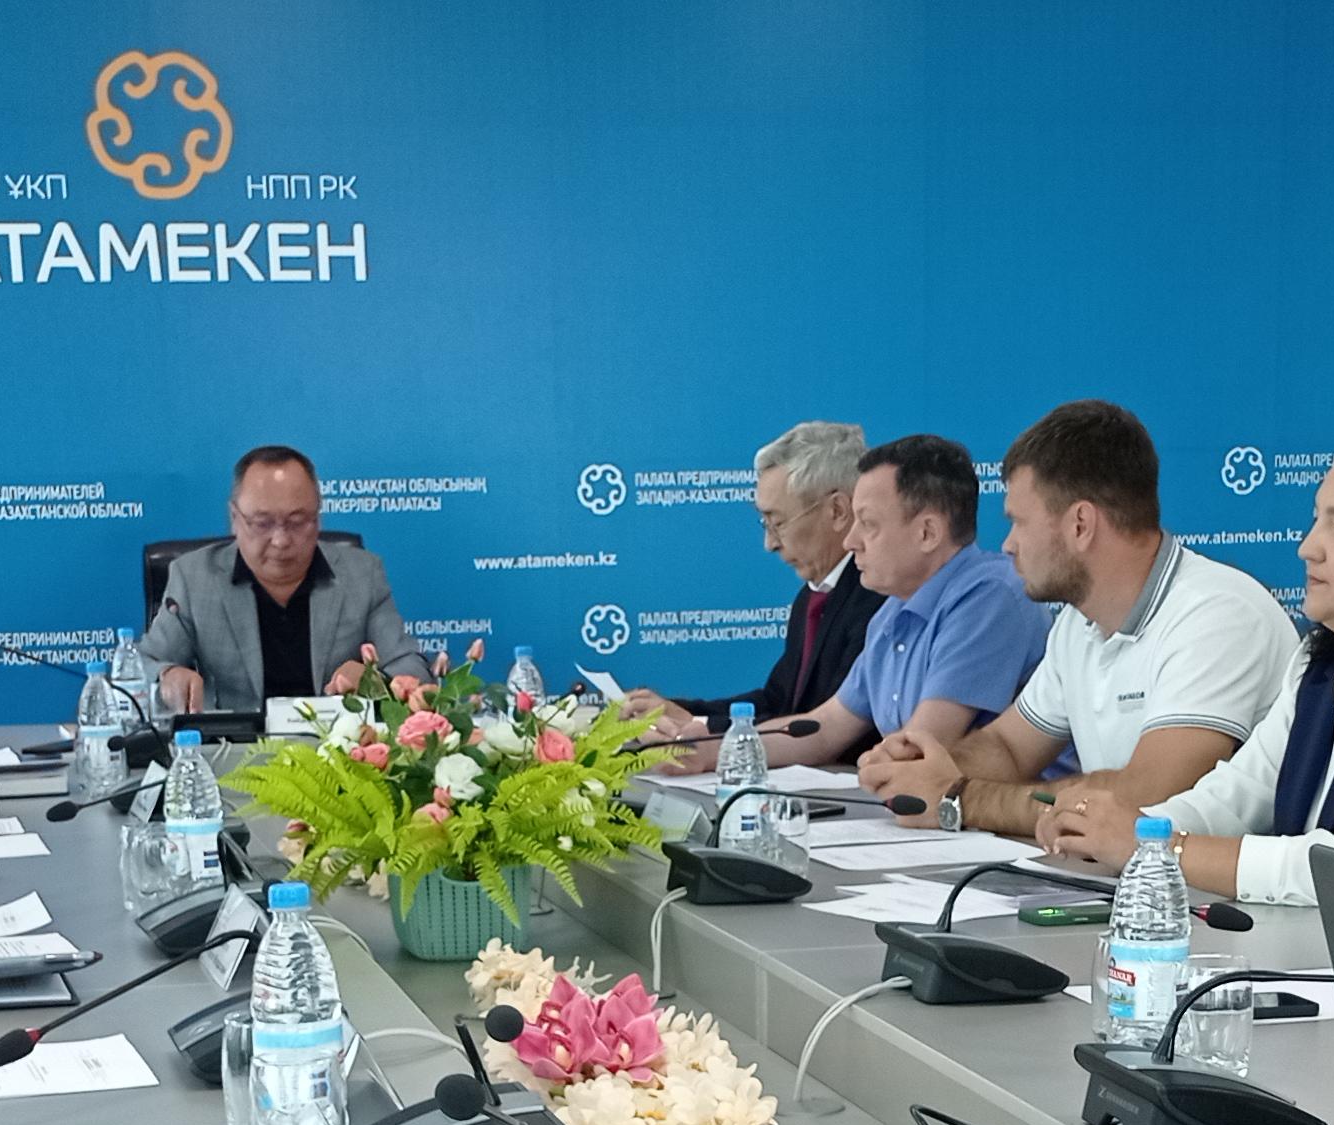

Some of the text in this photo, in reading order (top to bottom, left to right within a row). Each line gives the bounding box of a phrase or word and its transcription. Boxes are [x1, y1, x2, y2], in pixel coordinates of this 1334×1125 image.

[5, 174, 67, 200] ҰКП
[246, 175, 358, 200] НПП РК
[1274, 453, 1312, 468] ПАЛАТА
[972, 462, 1004, 477] АТЫС
[635, 472, 676, 487] ПАЛАТА
[89, 503, 143, 518] ОБЛАСТИ
[381, 497, 442, 511] ПАЛАТАСЫ
[1174, 528, 1303, 545] www.atameken.kz
[473, 551, 618, 570] www.atameken.kz
[1271, 587, 1307, 601] ПАЛАТА
[638, 612, 679, 627] ПАЛАТА
